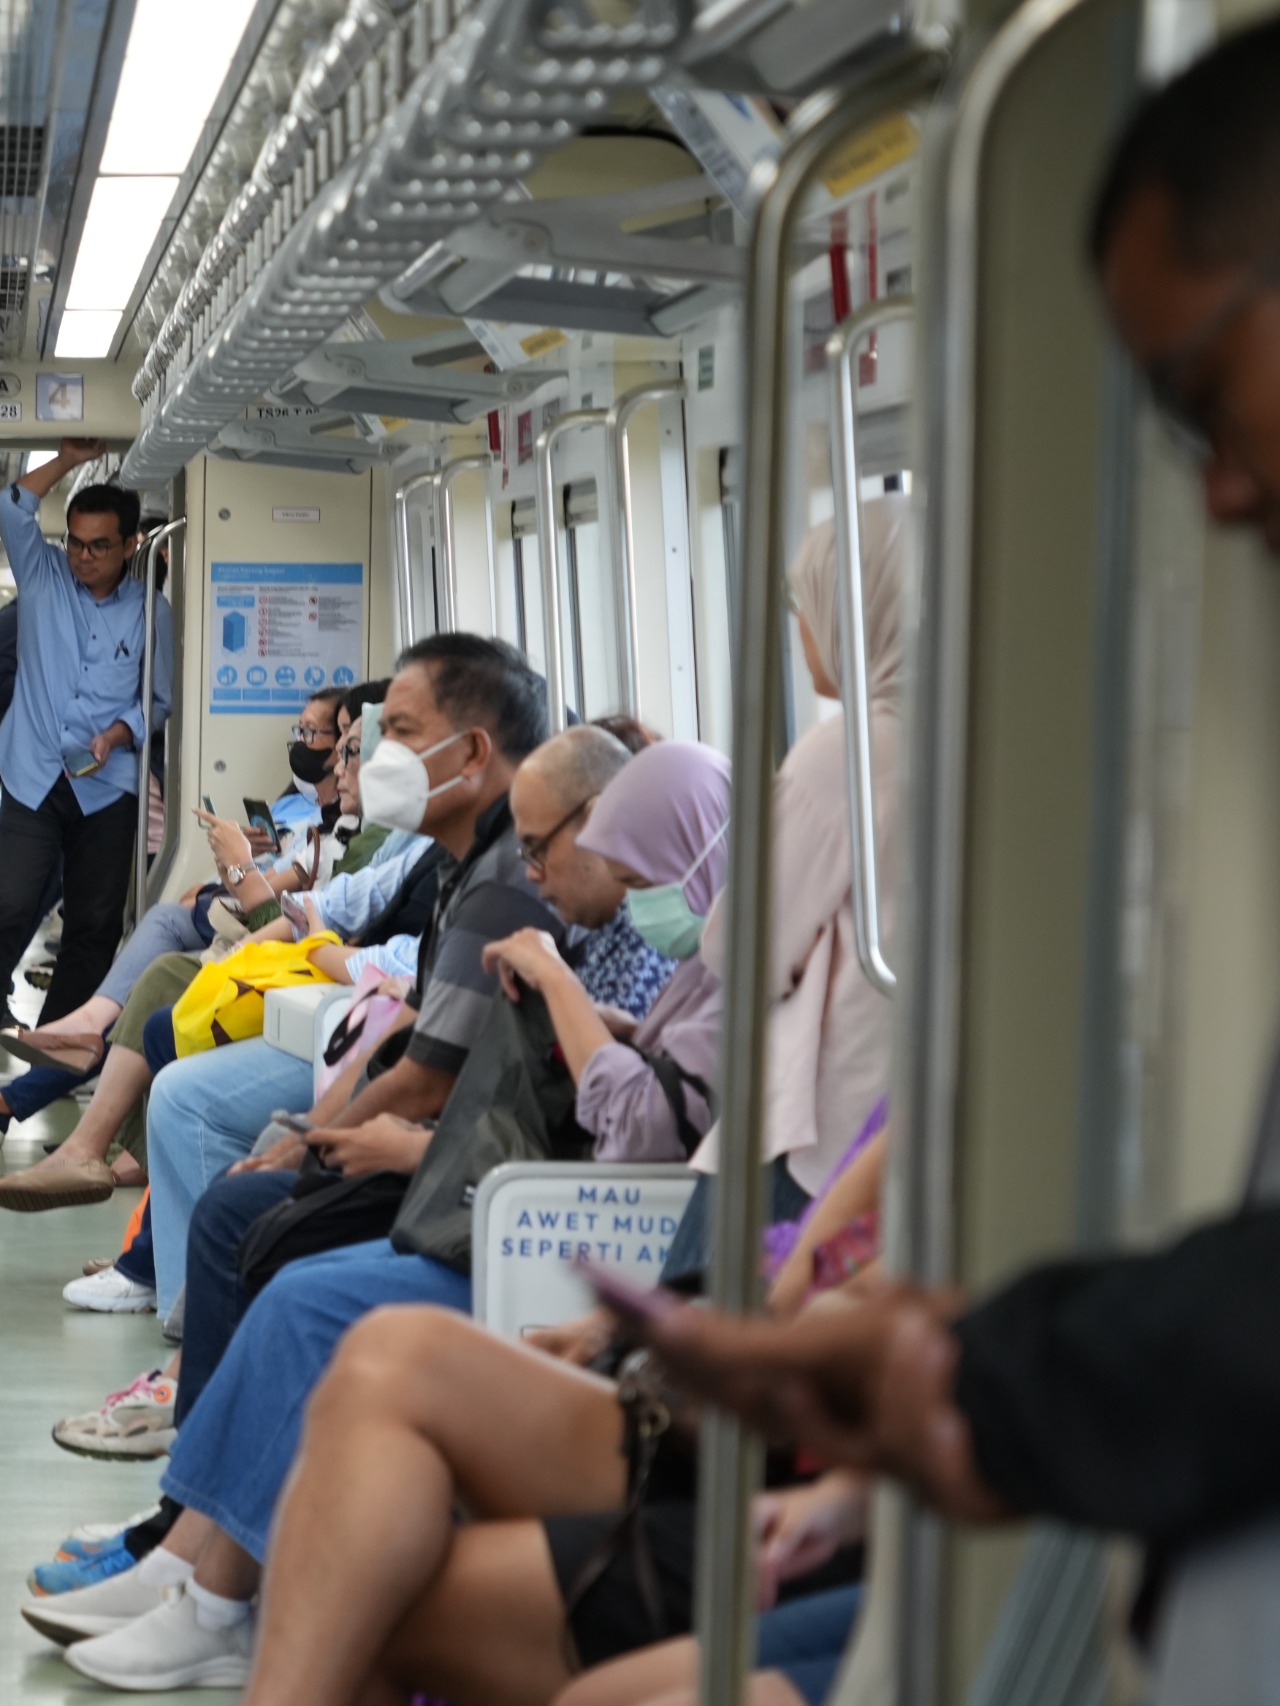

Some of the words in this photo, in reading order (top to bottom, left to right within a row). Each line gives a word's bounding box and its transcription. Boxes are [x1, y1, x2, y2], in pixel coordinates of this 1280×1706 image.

[48, 383, 70, 409] 4
[578, 1186, 640, 1205] MAU
[517, 1210, 598, 1231] AWET
[614, 1215, 677, 1235] MUD
[502, 1237, 621, 1262] SEPERTI
